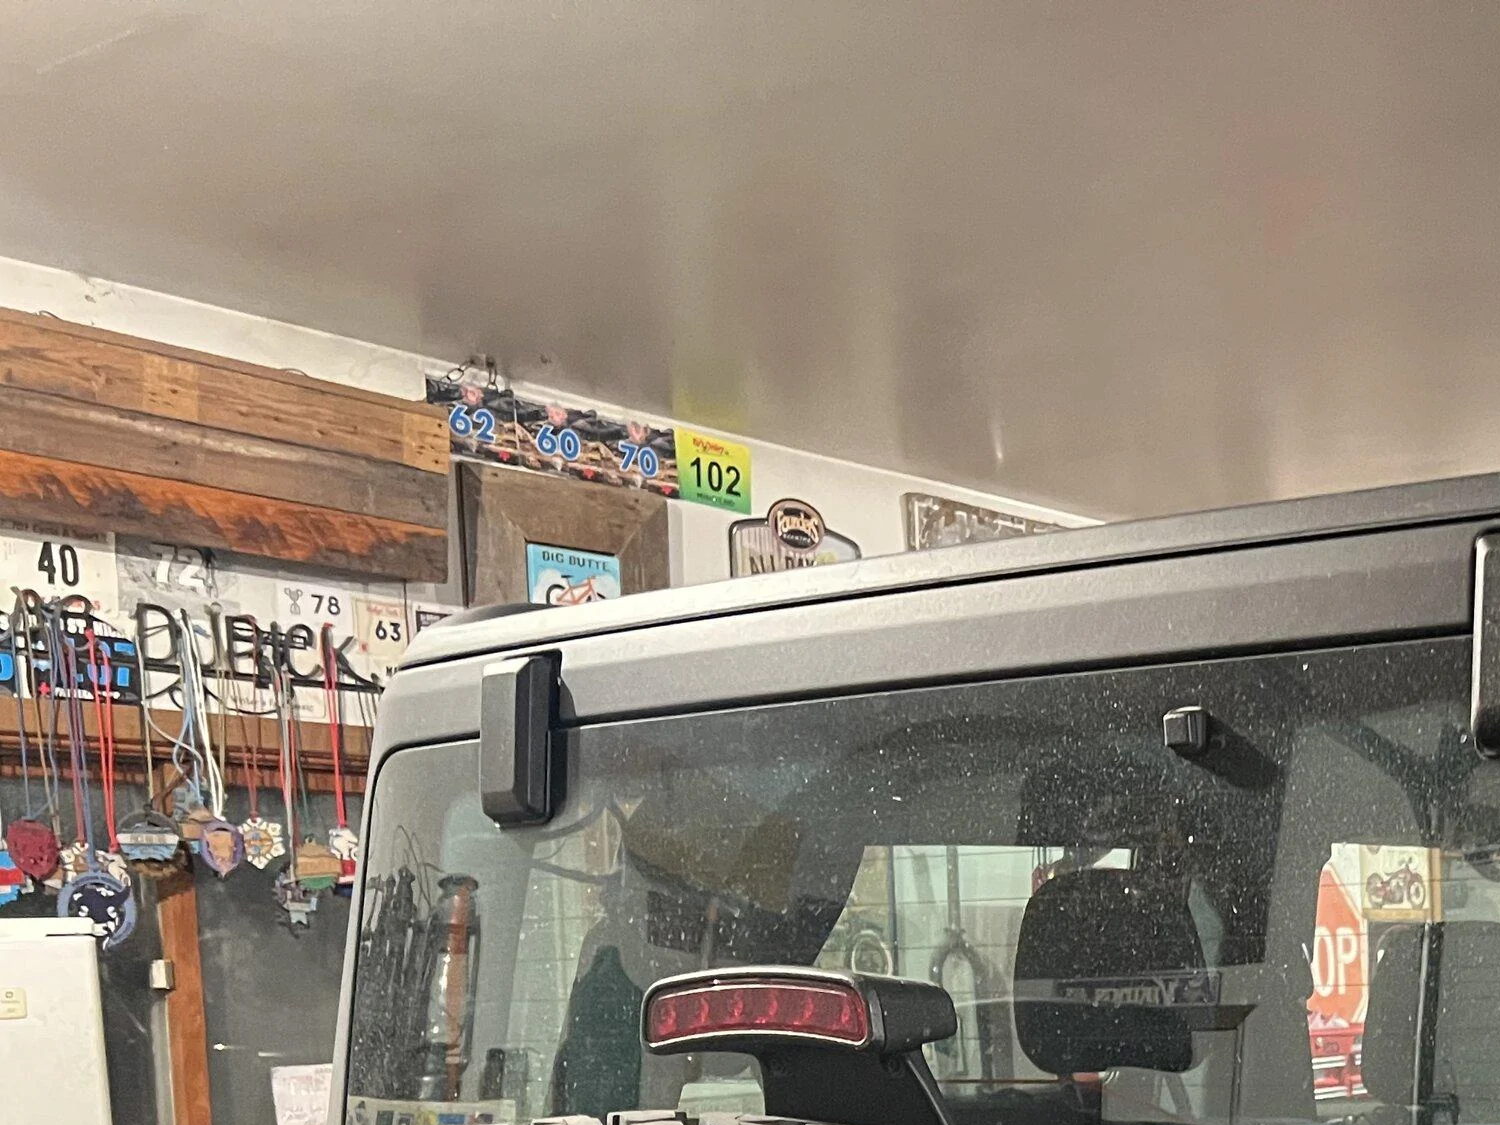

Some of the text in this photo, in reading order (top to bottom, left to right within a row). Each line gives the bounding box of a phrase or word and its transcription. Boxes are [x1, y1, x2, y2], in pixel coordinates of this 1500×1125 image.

[450, 404, 497, 443] 62
[536, 425, 581, 461] 60
[618, 441, 659, 477] 70
[690, 457, 741, 498] 102
[38, 541, 80, 587] 40
[149, 542, 206, 588] 72
[542, 551, 609, 571] BIG BUTTE
[311, 594, 341, 616] 78
[375, 620, 400, 642] 63
[1313, 926, 1357, 998] OP
